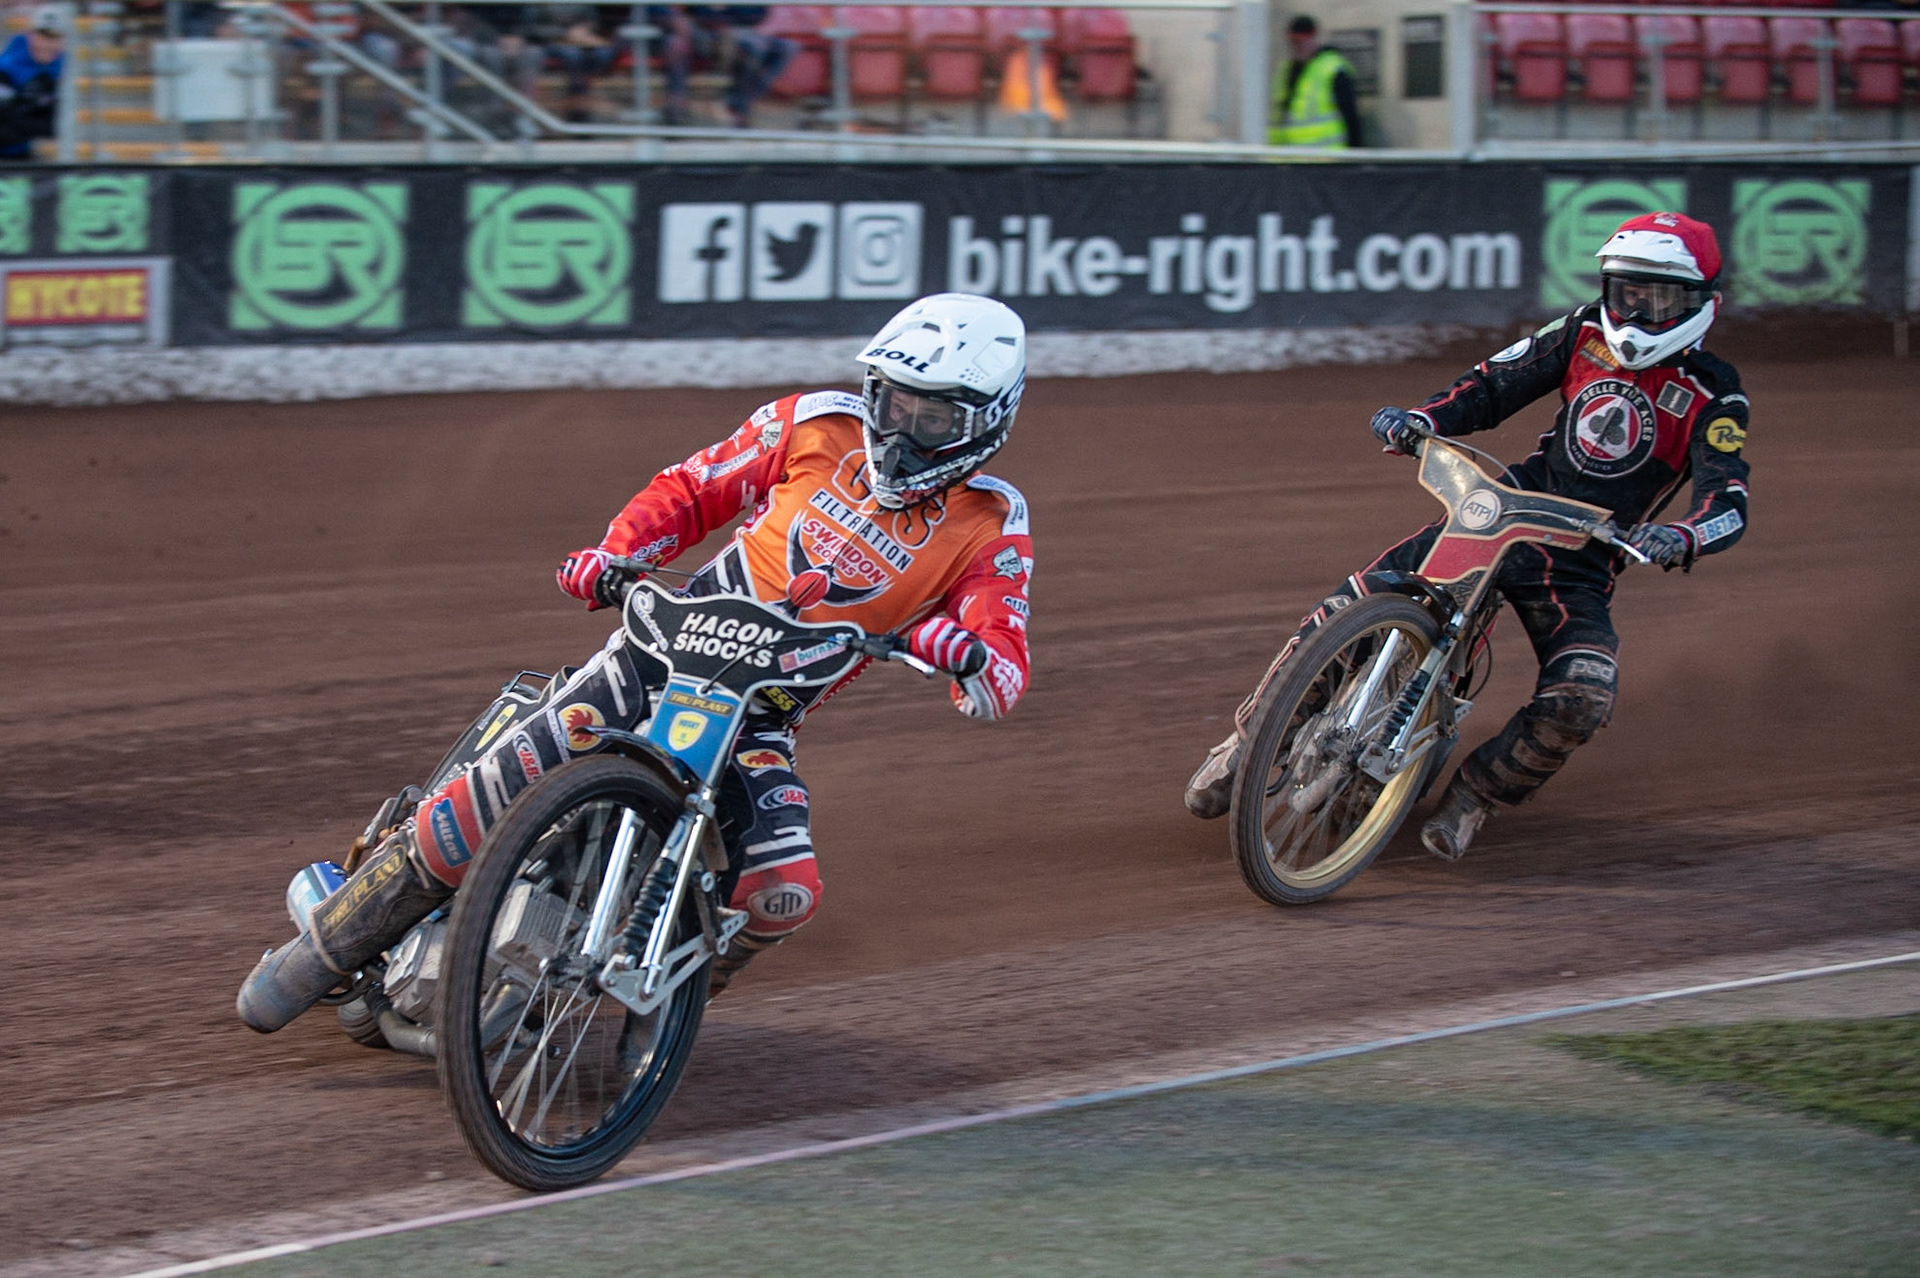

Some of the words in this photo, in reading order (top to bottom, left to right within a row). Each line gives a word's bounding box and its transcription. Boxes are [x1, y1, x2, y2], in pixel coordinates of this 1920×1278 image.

[948, 212, 1521, 312] bike-right.com
[866, 348, 929, 373] BOLL
[1582, 382, 1616, 402] BELLE
[1640, 410, 1653, 442] ACES
[811, 491, 912, 572] FILTRATION
[802, 519, 886, 585] SWINDON
[680, 612, 784, 648] HAGON
[673, 632, 774, 668] SHOCKS
[761, 686, 797, 712] ESS
[764, 892, 803, 915] GM
